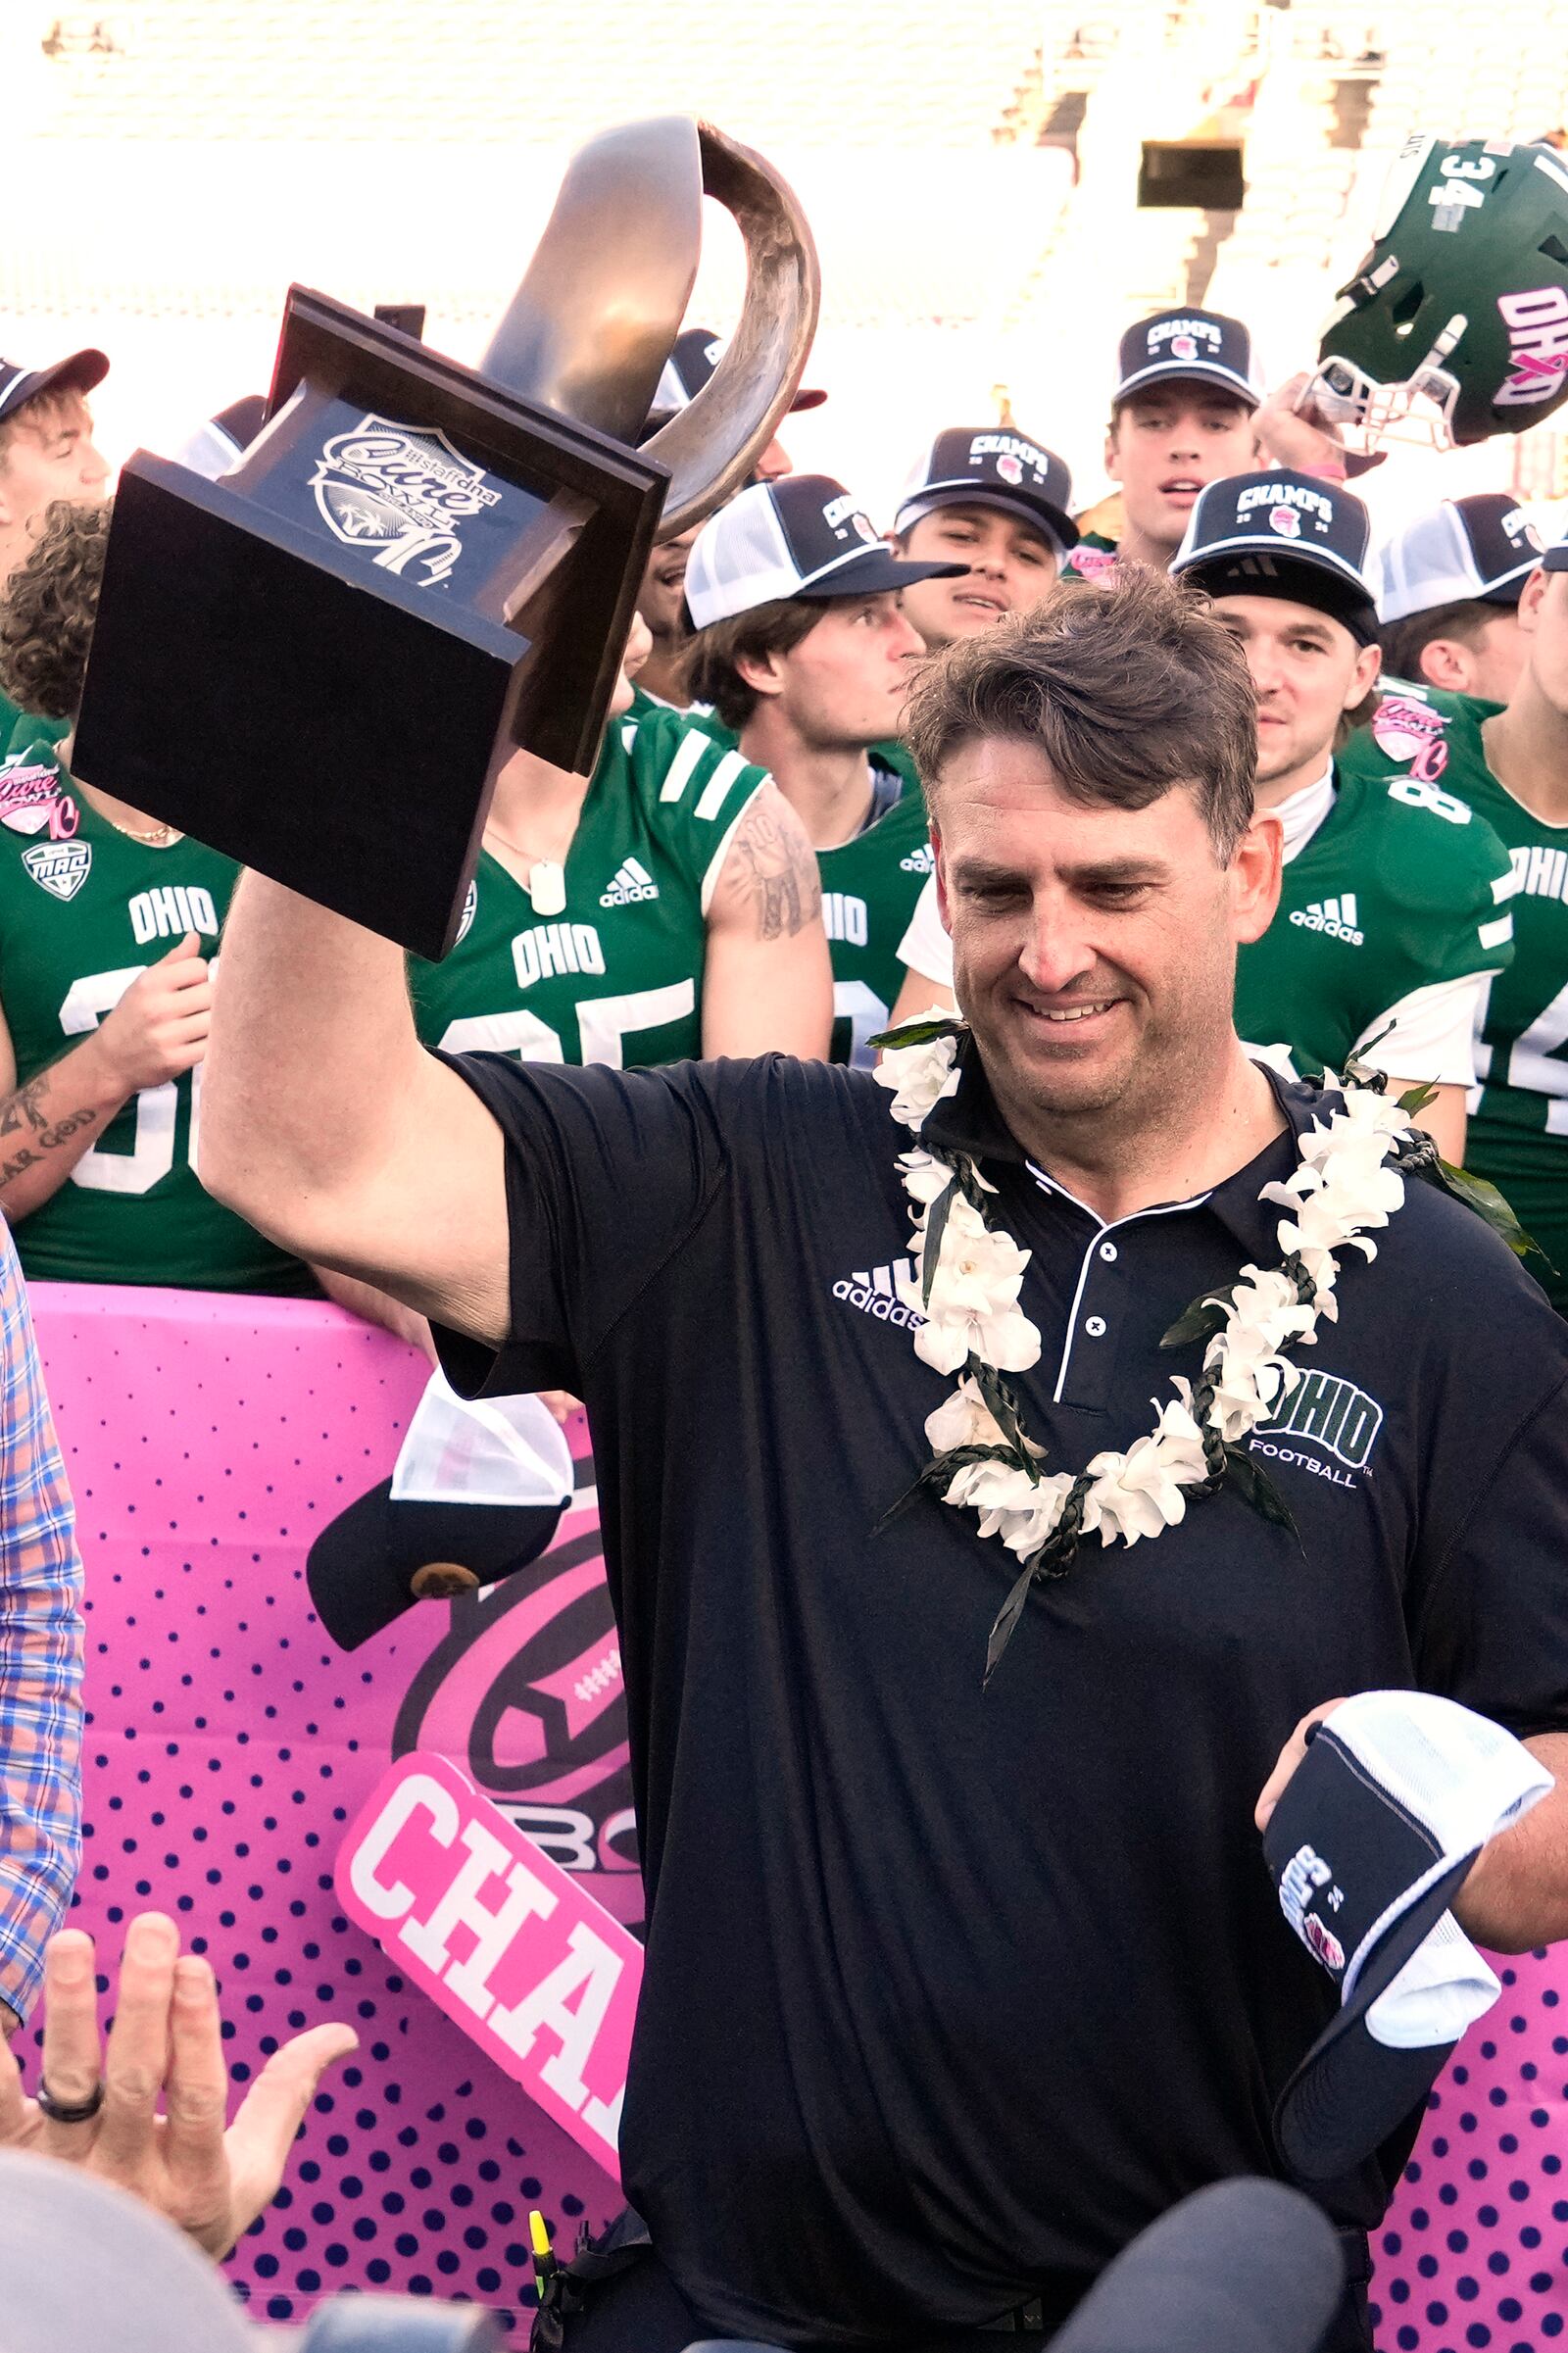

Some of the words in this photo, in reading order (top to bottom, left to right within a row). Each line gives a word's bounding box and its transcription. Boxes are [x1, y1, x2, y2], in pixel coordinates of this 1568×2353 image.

[1428, 154, 1496, 208] 34
[326, 434, 478, 513] Cure
[337, 457, 460, 531] BOWL
[419, 455, 497, 505] staffdna
[1236, 483, 1333, 523] CHAMPS
[371, 525, 463, 587] 10
[1388, 778, 1472, 825] 8
[32, 853, 89, 881] MAC
[128, 886, 219, 945] OHIO
[1289, 909, 1365, 947] adidas
[511, 922, 607, 989] OHIO
[831, 1280, 924, 1331] adidas
[1249, 1439, 1357, 1489] FOOTBALL
[350, 1773, 627, 2152] CHA
